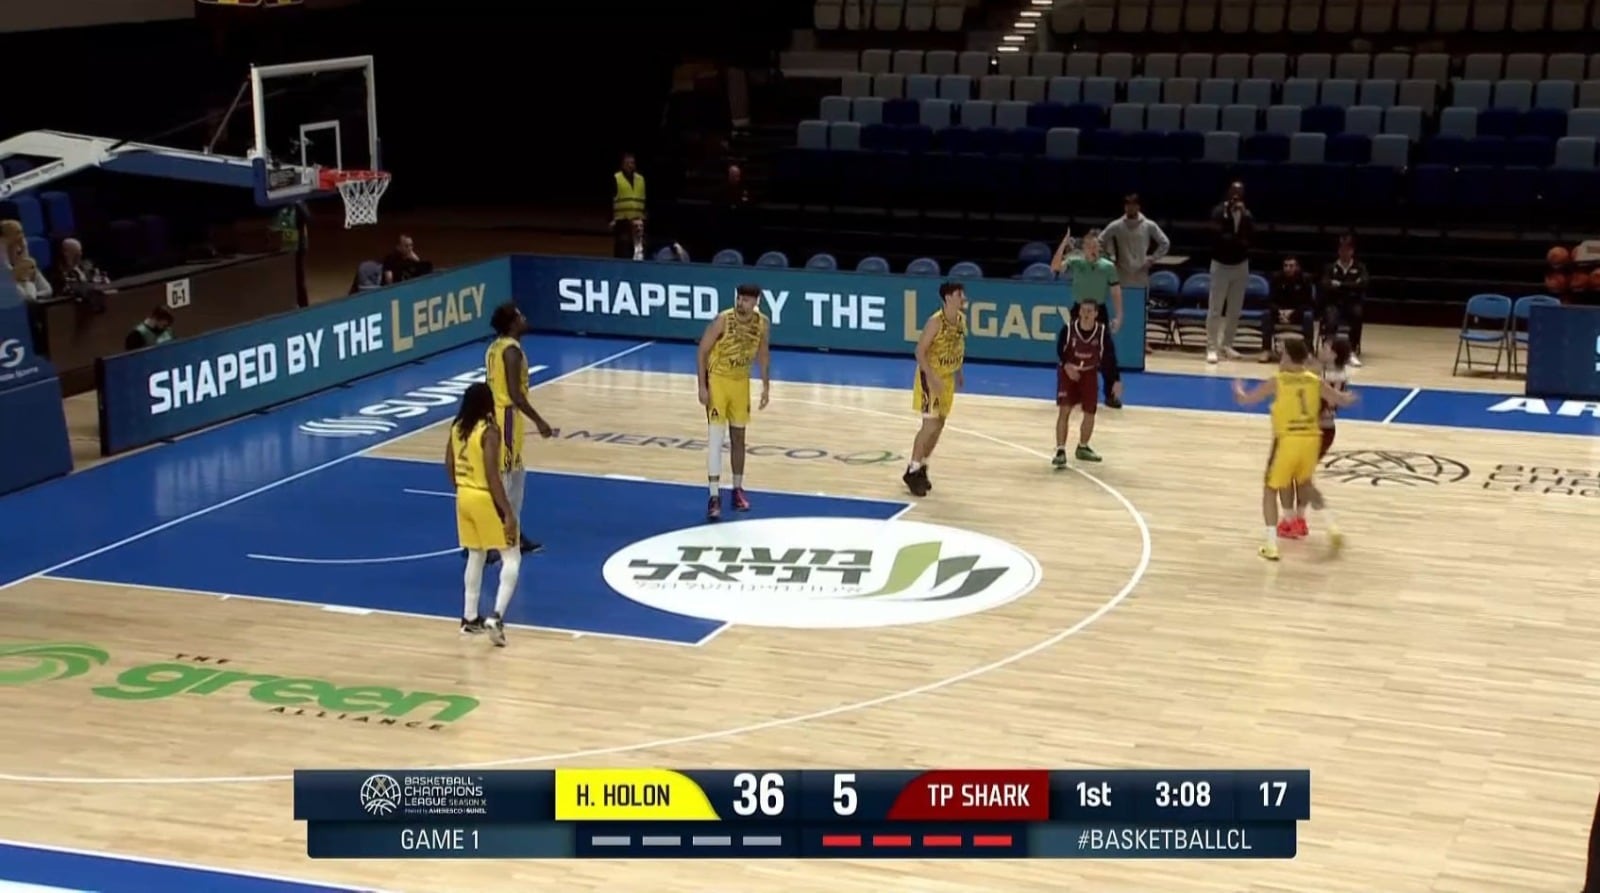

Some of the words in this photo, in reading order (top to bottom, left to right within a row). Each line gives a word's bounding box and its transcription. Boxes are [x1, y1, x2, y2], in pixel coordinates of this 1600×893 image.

[558, 277, 719, 320] SHAPED
[735, 287, 790, 325] Y
[805, 292, 886, 332] THE
[904, 289, 1071, 342] LGAC
[149, 343, 277, 415] SHAPED
[287, 328, 324, 376] BY
[333, 313, 383, 360] THE
[391, 283, 486, 353] LEGACY
[542, 427, 827, 460] MERECO
[677, 546, 873, 566] מעוז
[628, 559, 871, 585] דניאל
[175, 653, 231, 665] THE
[91, 662, 481, 723] green
[270, 705, 444, 731] ALLIANCE
